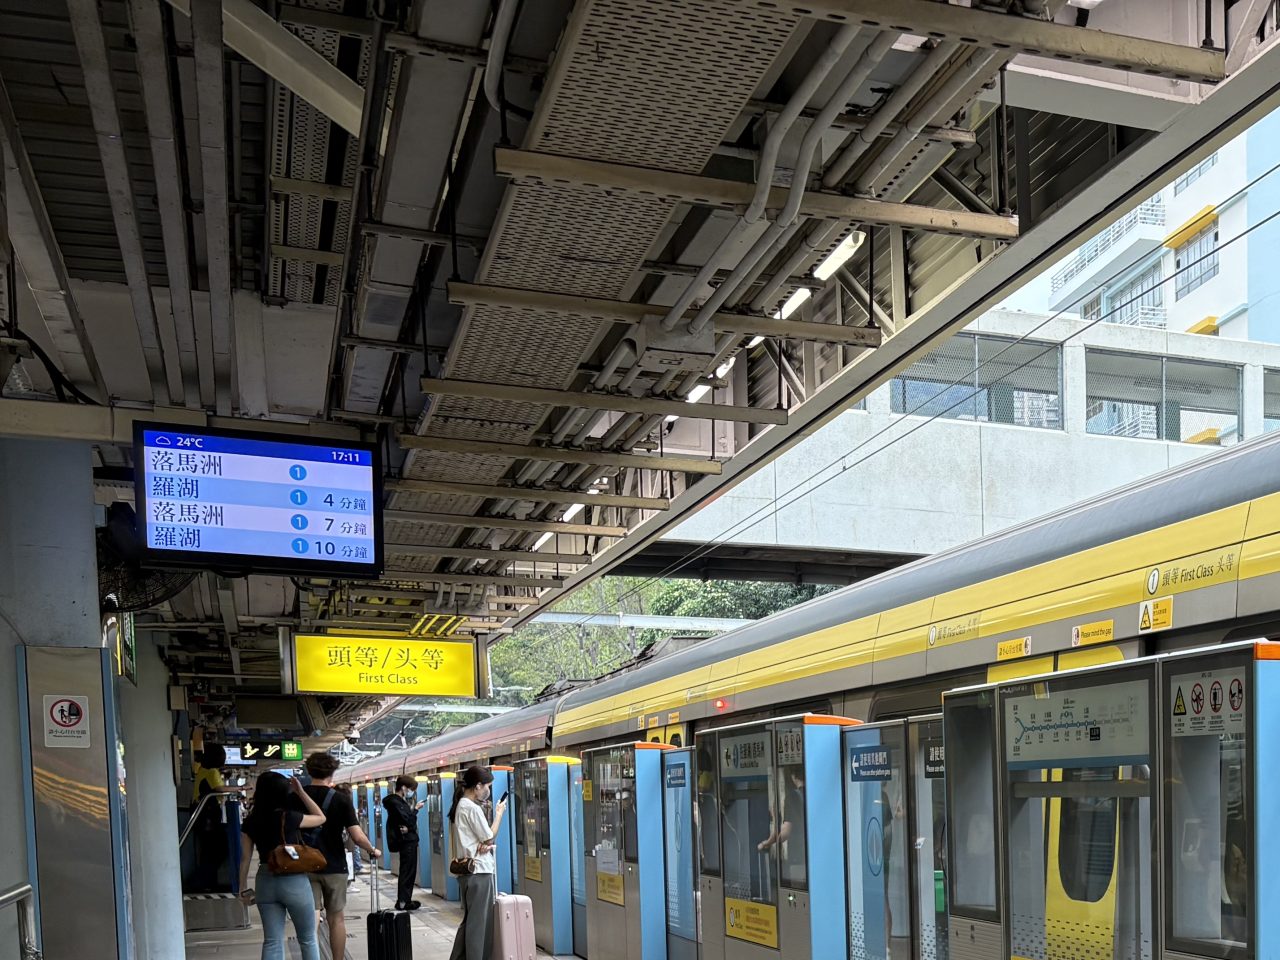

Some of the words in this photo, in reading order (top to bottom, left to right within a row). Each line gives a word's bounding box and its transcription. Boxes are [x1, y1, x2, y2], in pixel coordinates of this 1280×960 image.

[151, 450, 223, 477] 落馬洲
[331, 450, 360, 463] 17:11
[152, 476, 200, 499] 羅湖
[323, 493, 335, 507] 4
[339, 497, 367, 512] 分鐘
[153, 501, 224, 527] 落馬洲
[324, 518, 335, 531] 7
[340, 521, 368, 536] 分鐘
[154, 526, 201, 549] 羅湖
[315, 541, 335, 555] 10
[341, 545, 368, 559] 分鐘
[1180, 567, 1196, 583] First
[1196, 563, 1214, 579] Class
[327, 645, 445, 670] 頭等/头等
[358, 673, 385, 684] First
[387, 673, 419, 685] Class
